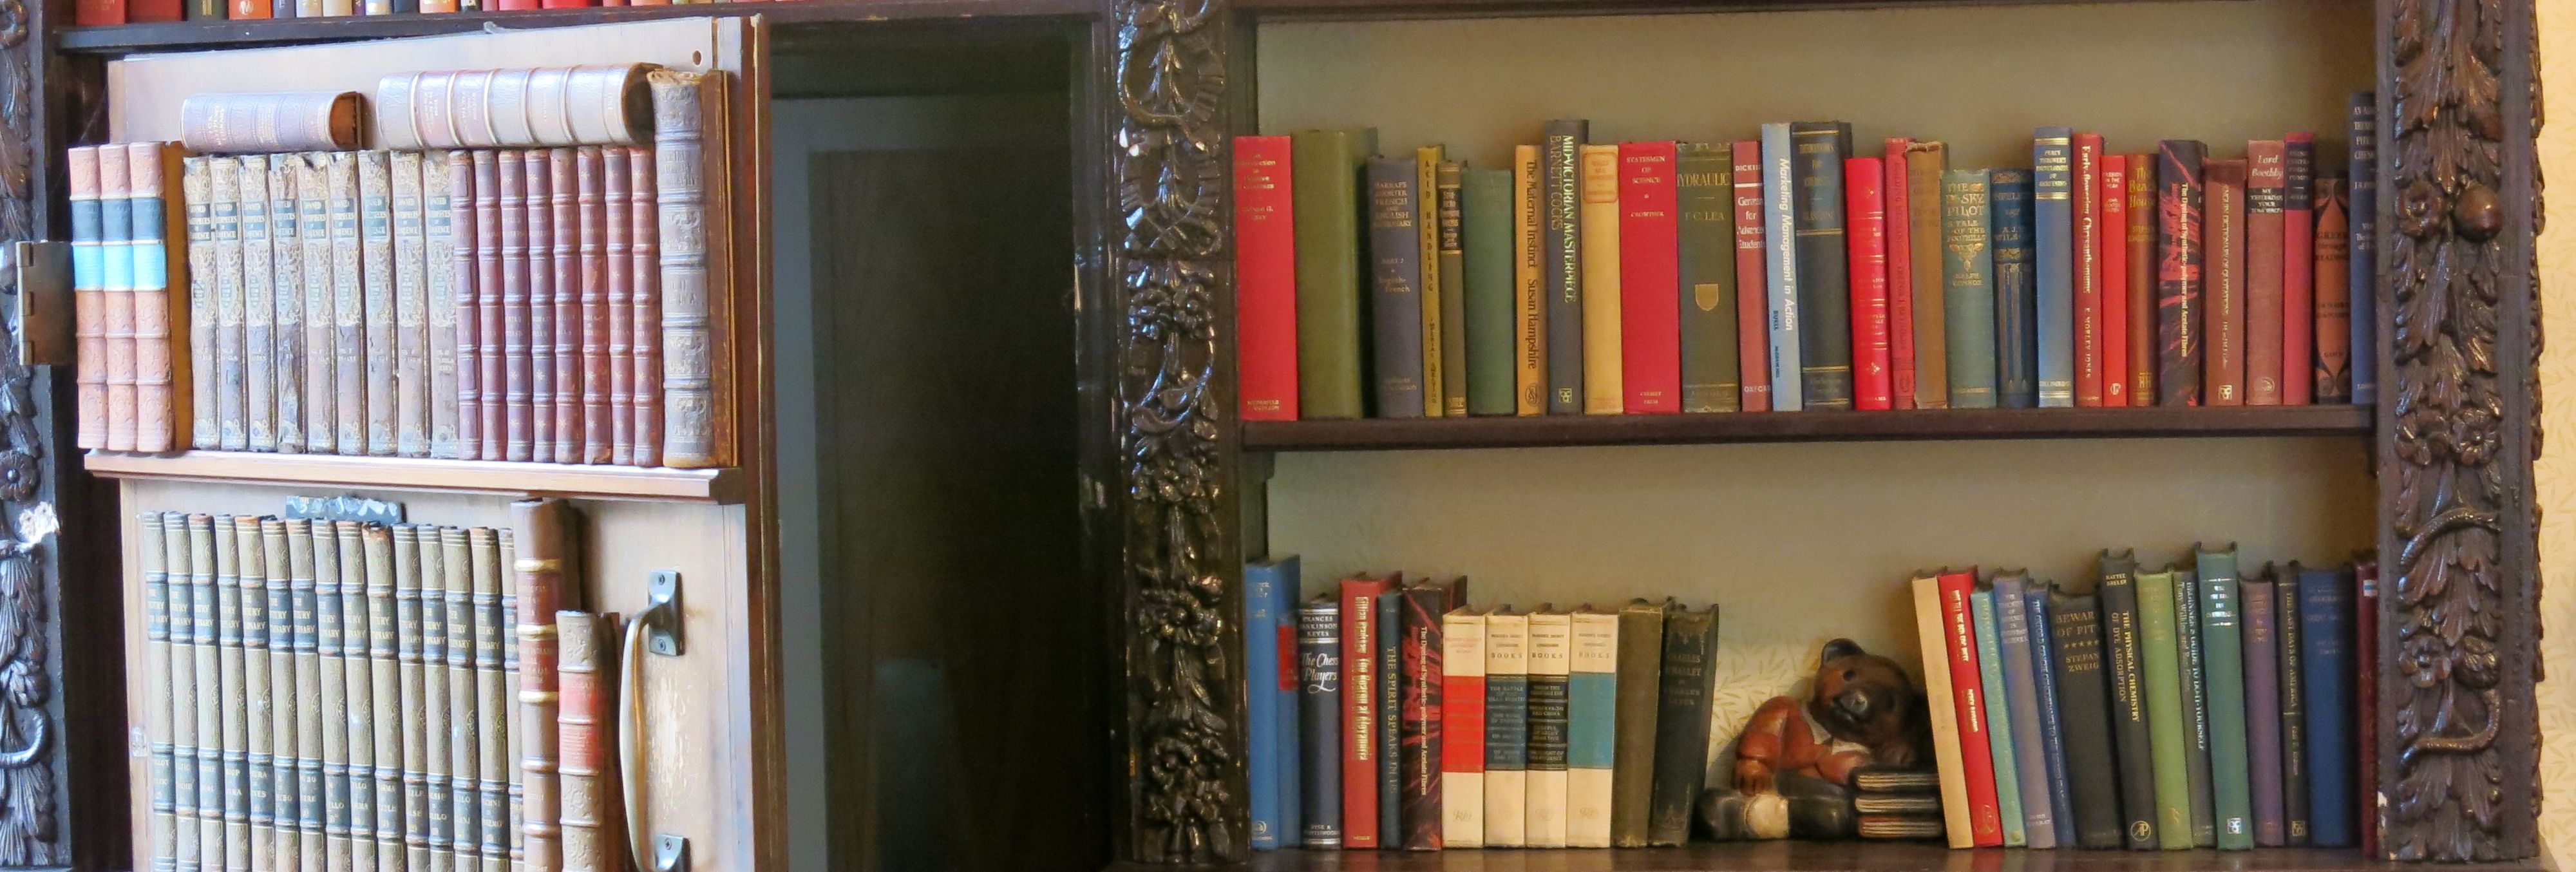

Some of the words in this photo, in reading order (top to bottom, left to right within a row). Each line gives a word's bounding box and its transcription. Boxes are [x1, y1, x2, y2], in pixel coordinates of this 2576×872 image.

[2258, 155, 2279, 164] Lord
[1562, 135, 1575, 220] MID-VICTORIAN
[1779, 158, 1793, 211] Marketing
[1526, 180, 1538, 227] Maternal
[1947, 205, 1984, 216] PILOT
[1960, 194, 1985, 204] SKY
[2180, 198, 2188, 223] Dyeing
[1746, 211, 1757, 221] for
[1781, 214, 1794, 281] Management
[1527, 279, 1538, 310] Susan
[1785, 286, 1795, 294] in
[1785, 298, 1795, 330] Action
[1526, 313, 1540, 370] Hampshire
[2077, 625, 2097, 634] PIT
[1317, 652, 1339, 667] Chess
[1387, 646, 1397, 670] THE
[2124, 632, 2135, 671] PHYSICAL
[2190, 636, 2201, 667] GUIDE
[1387, 672, 1397, 711] SPIRIT
[2128, 672, 2140, 722] CHEMISTRY
